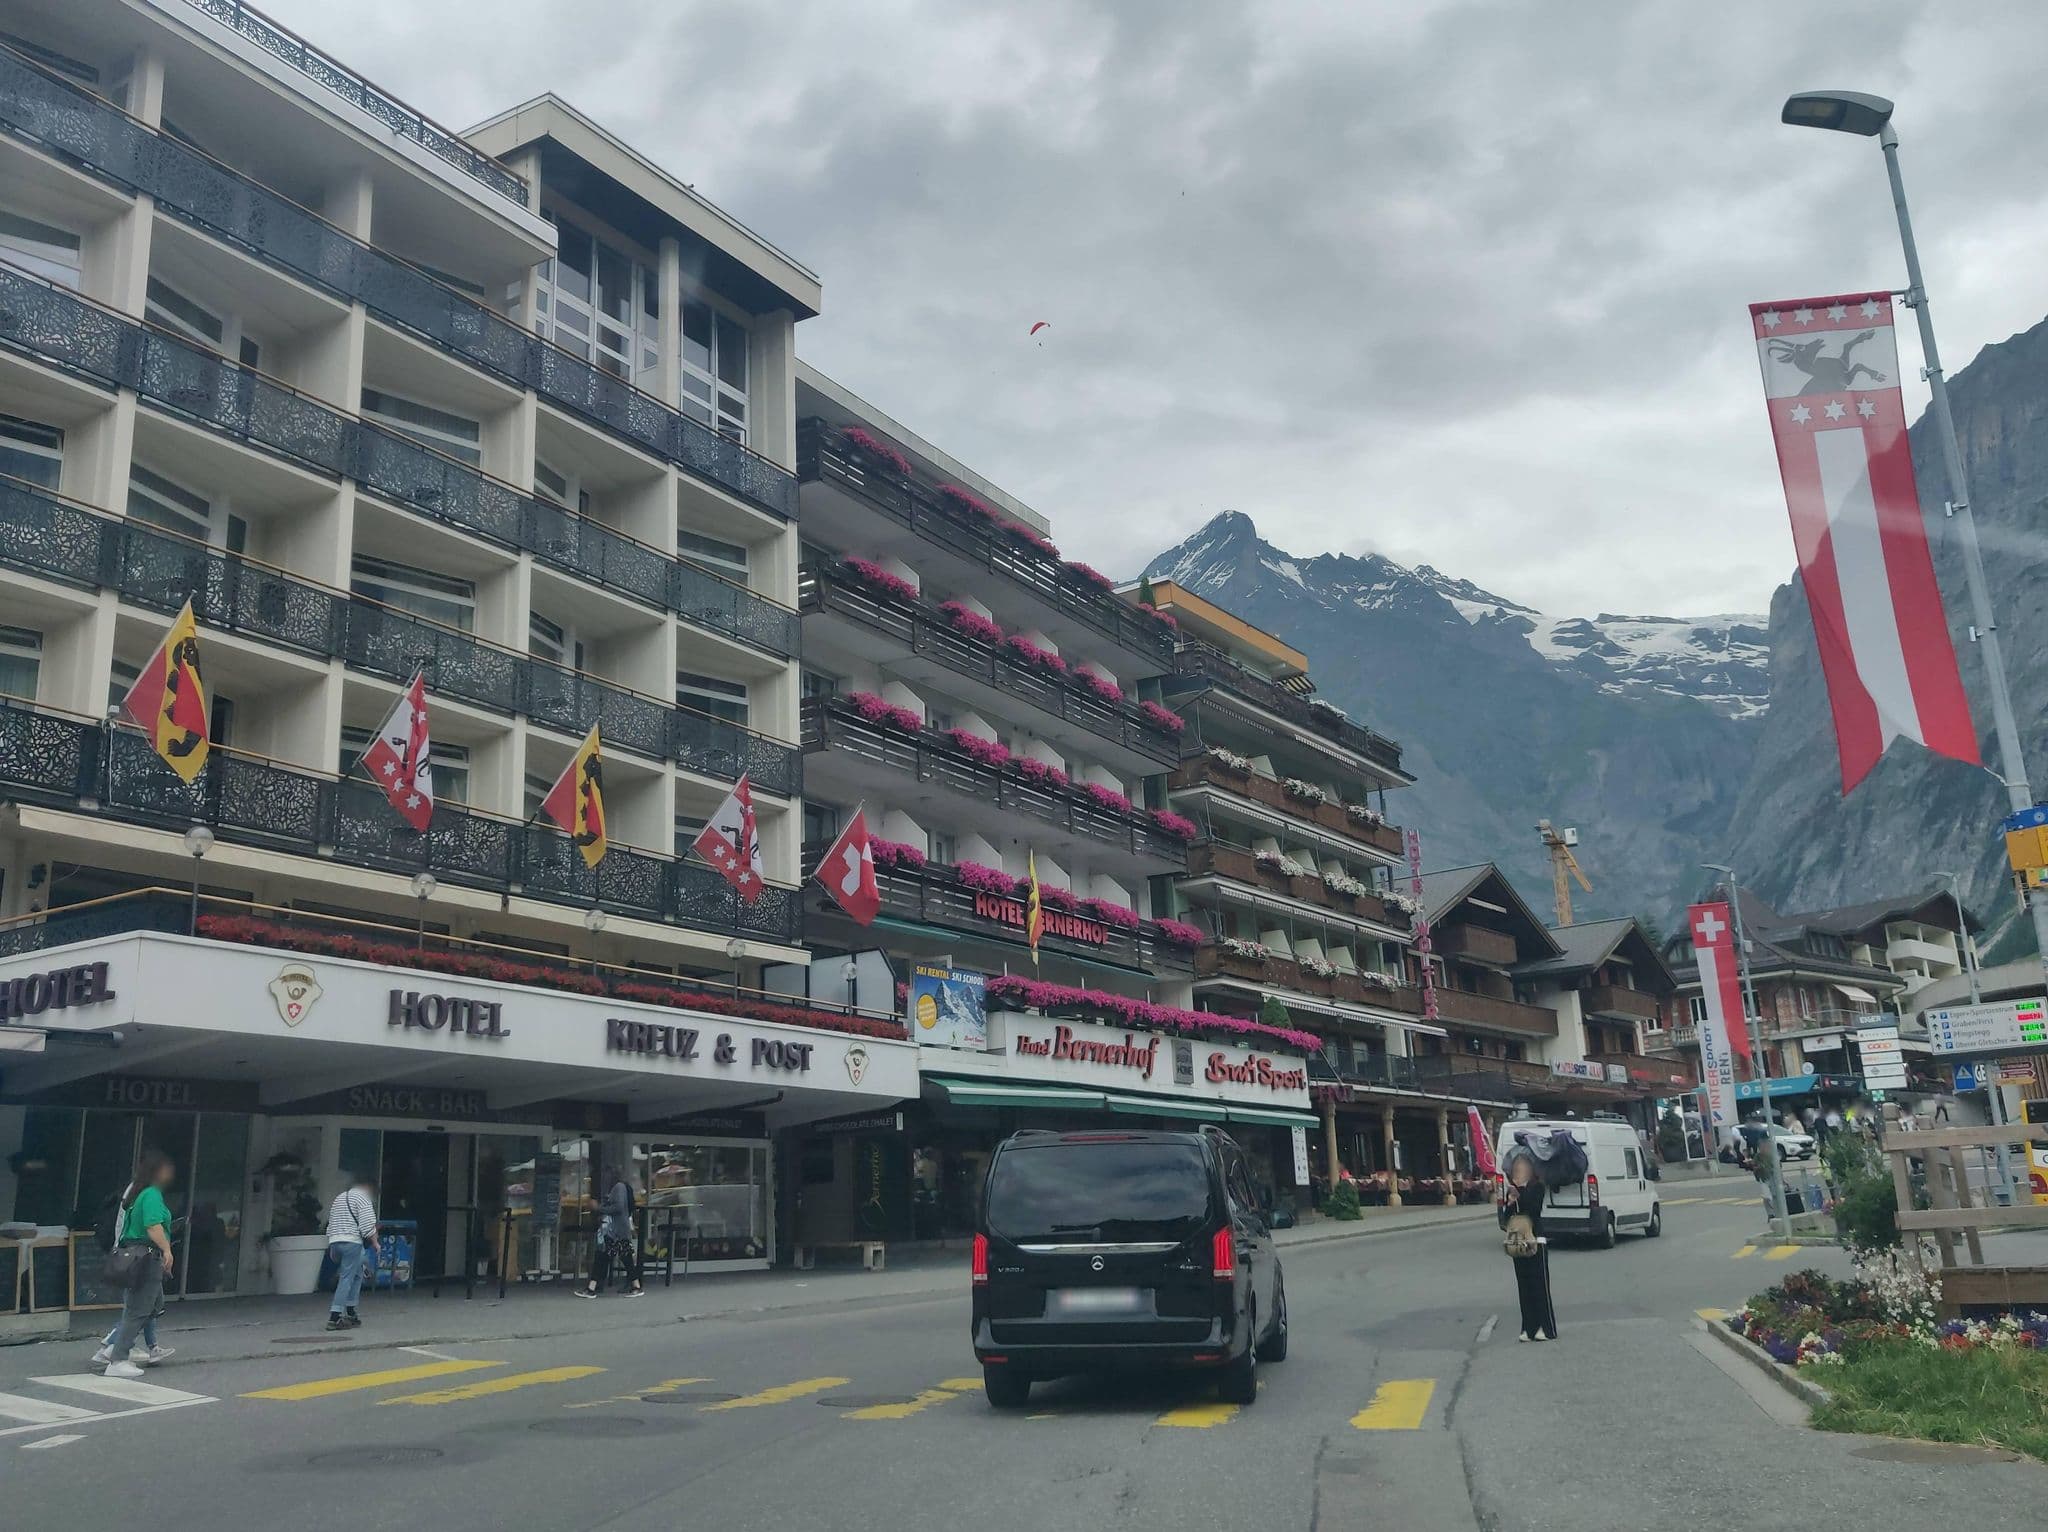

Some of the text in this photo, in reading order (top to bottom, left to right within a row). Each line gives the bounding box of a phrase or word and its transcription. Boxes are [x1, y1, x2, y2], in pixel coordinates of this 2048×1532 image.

[976, 893, 1109, 945] HOTEL ERNERHOF
[0, 961, 116, 1022] HOTEL
[916, 965, 984, 986] SKI RENTAL SKI SCHOOL
[388, 989, 814, 1071] HOTEL KREUZ & POST
[1016, 1025, 1160, 1081] Hotel Bernerhof
[1257, 1057, 1307, 1091] Sport
[106, 1079, 194, 1105] HOTEL
[348, 1086, 424, 1111] SNACK
[440, 1091, 482, 1115] BAR
